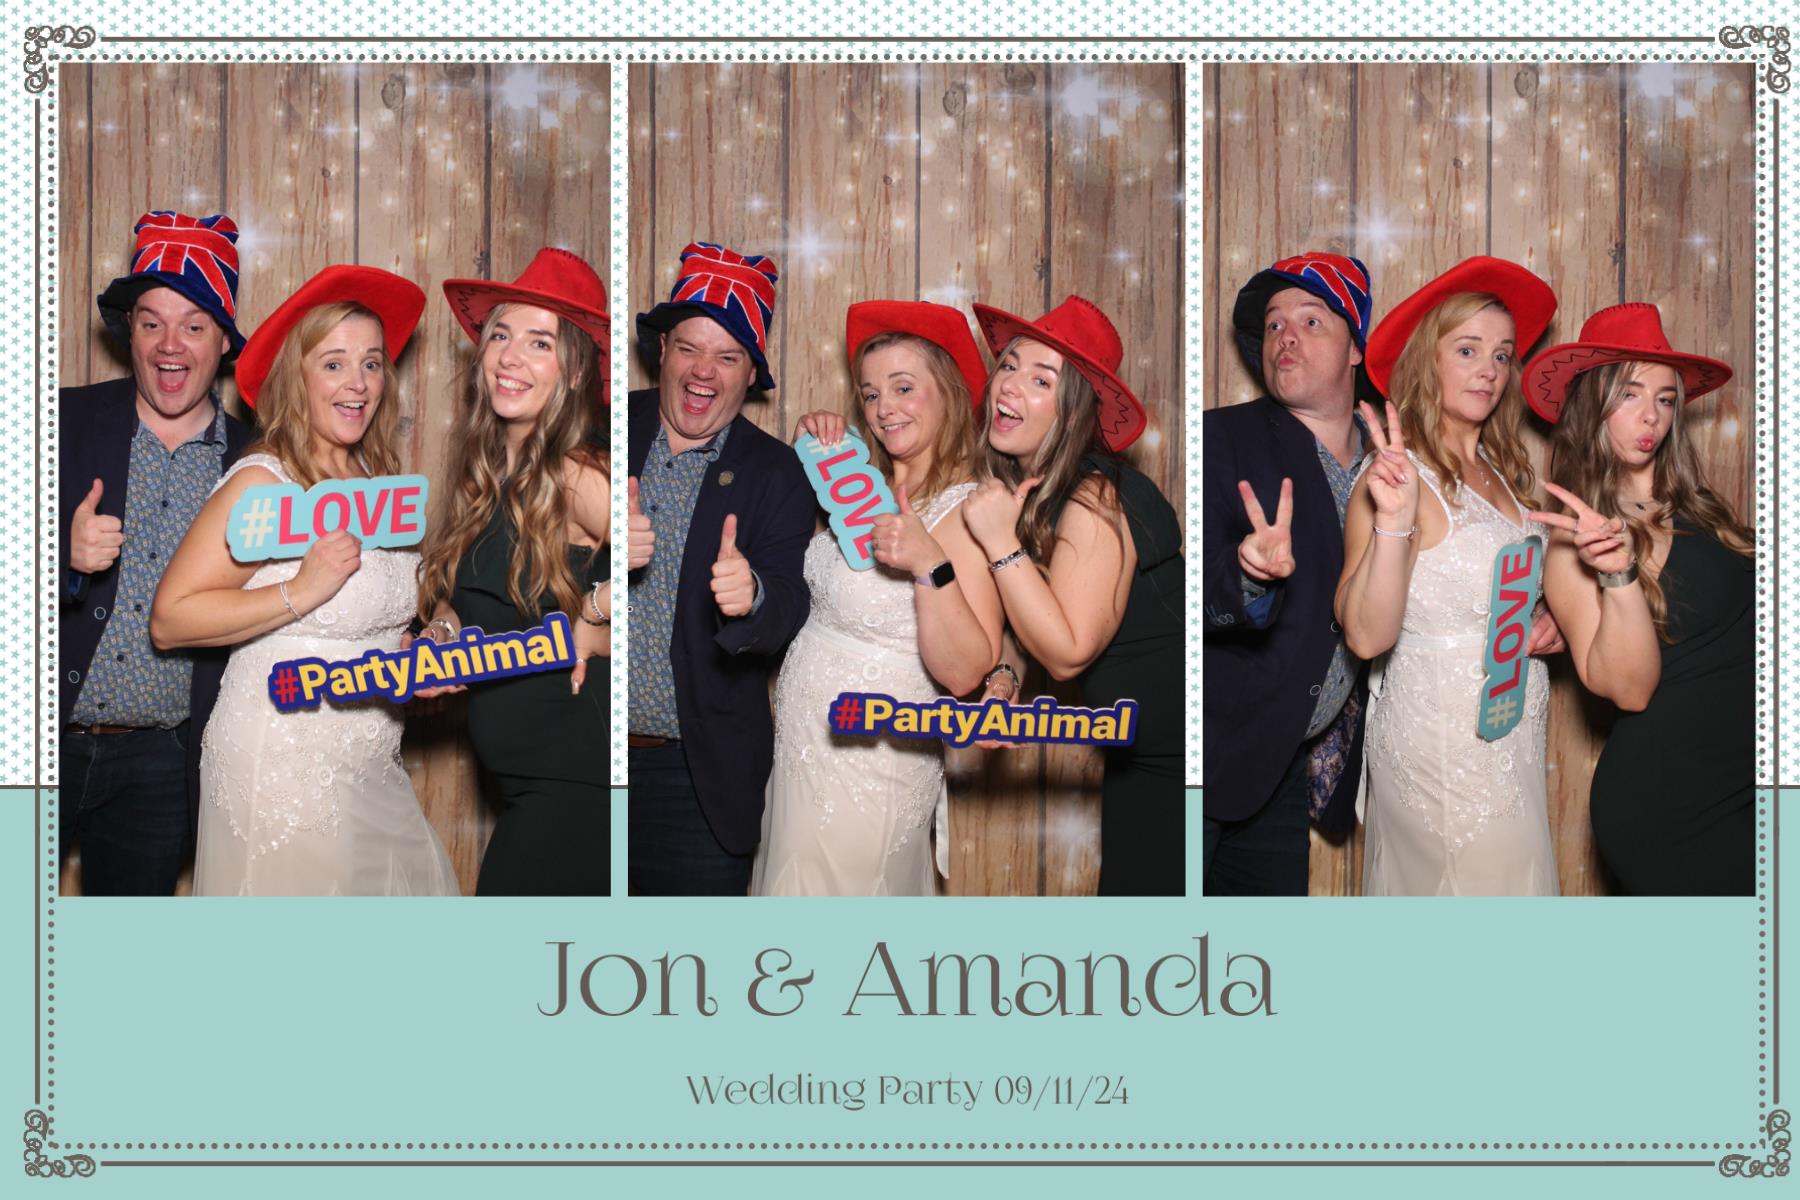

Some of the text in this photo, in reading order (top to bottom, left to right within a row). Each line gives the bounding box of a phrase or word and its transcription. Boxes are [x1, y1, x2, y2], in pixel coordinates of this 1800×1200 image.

[239, 486, 420, 549] #LOVE
[274, 619, 569, 705] #PartyAnimal
[1486, 546, 1534, 729] #LOVE
[834, 697, 1132, 743] #PartyAnimal
